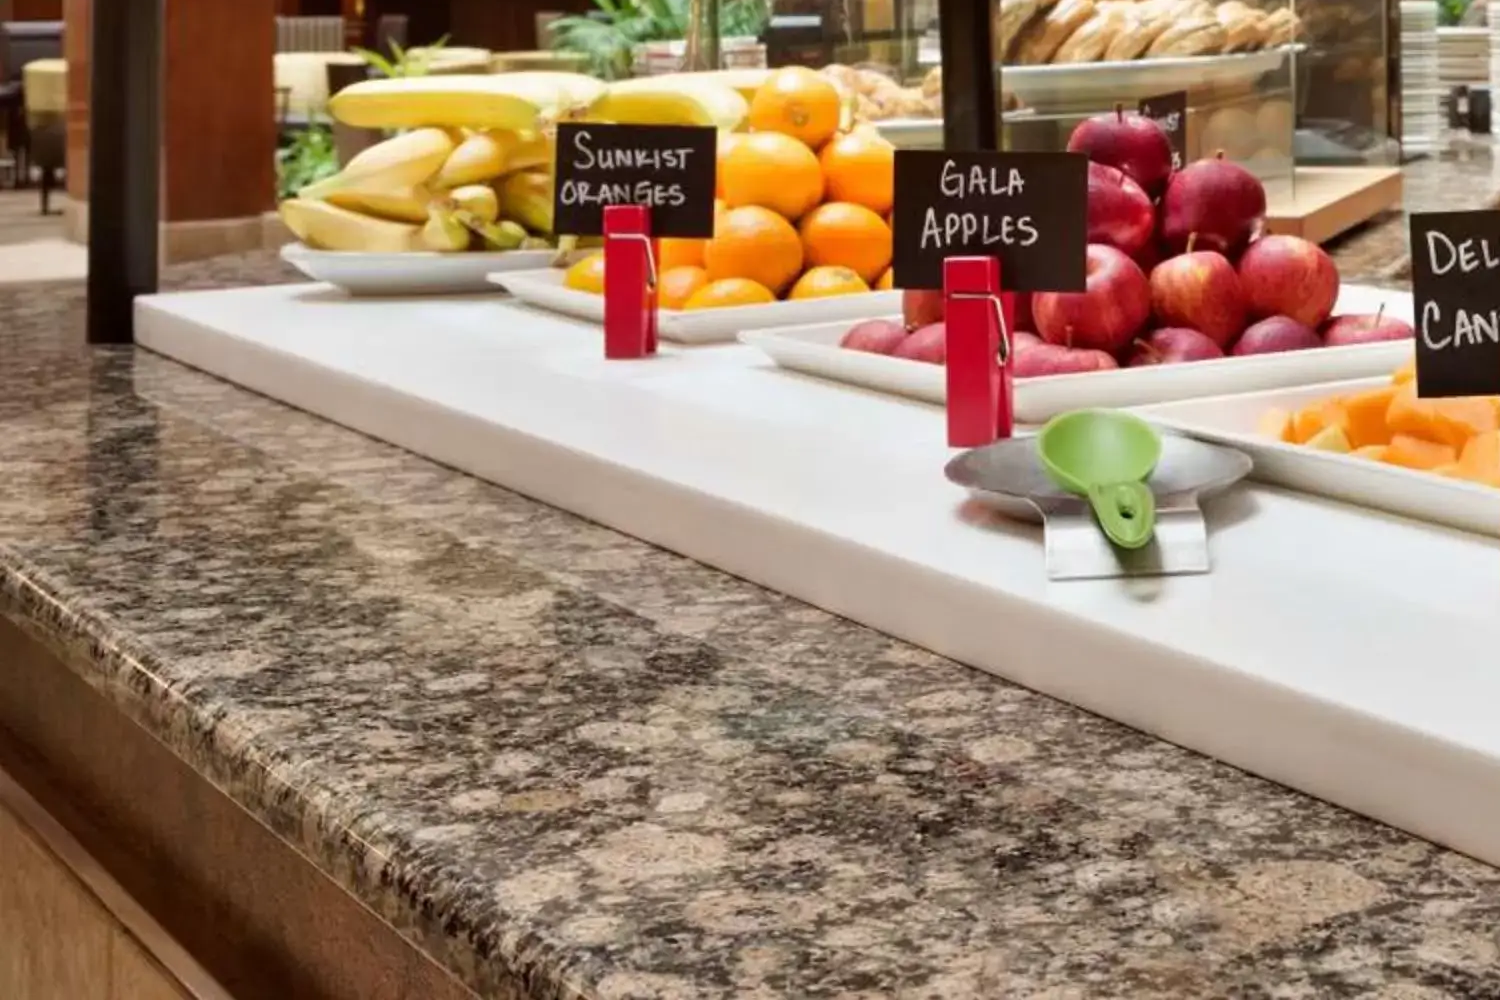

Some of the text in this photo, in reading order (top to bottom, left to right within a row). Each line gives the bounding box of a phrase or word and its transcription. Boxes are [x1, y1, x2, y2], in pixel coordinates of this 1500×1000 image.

[573, 130, 694, 170] SUNKIST
[560, 180, 686, 207] ORANGES
[940, 159, 1025, 198] GALA
[920, 206, 1039, 249] APPLES
